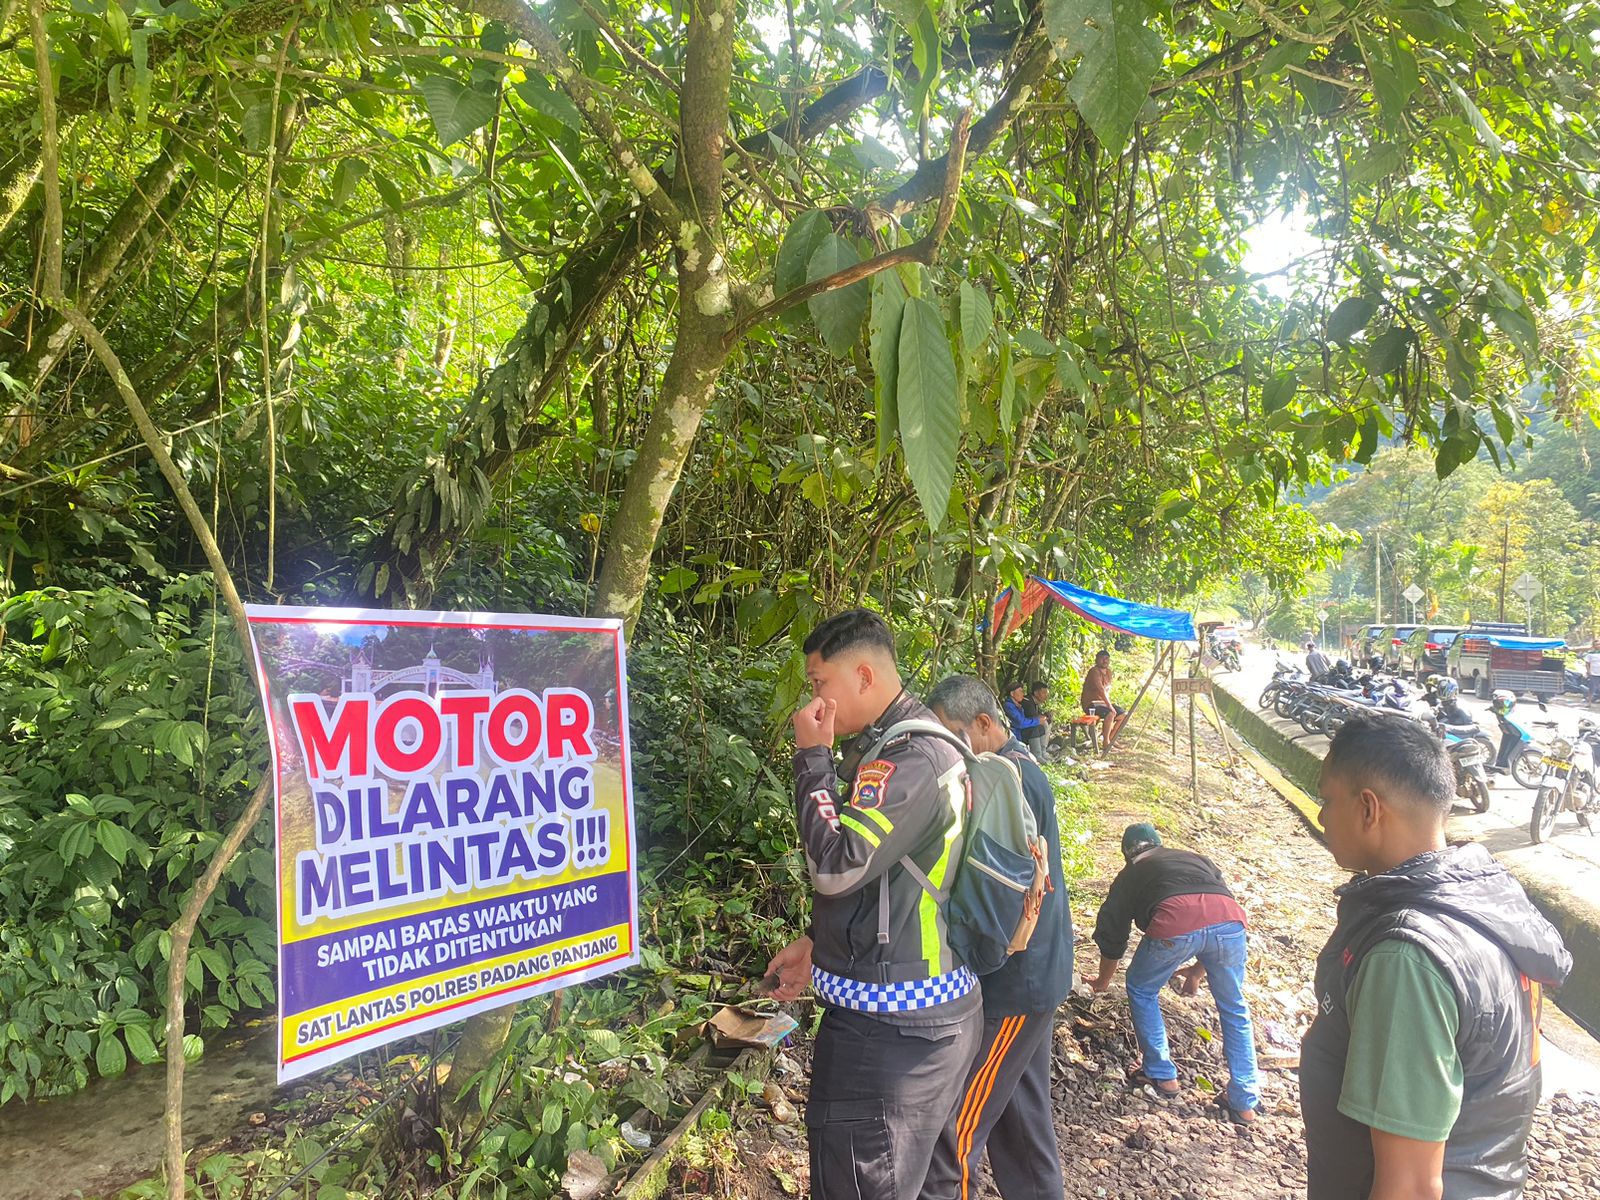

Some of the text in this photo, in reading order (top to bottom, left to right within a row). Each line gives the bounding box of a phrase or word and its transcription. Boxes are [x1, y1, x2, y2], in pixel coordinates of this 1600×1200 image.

[293, 693, 593, 779] MOTOR
[315, 766, 590, 845] DILARANG
[316, 884, 598, 968] SAMPAI BATAS WAKTU YANG
[362, 914, 563, 982] TIDAK DITENTUKAN
[298, 935, 618, 1045] SAT LANTAS POLRES PADANG PANJANG
